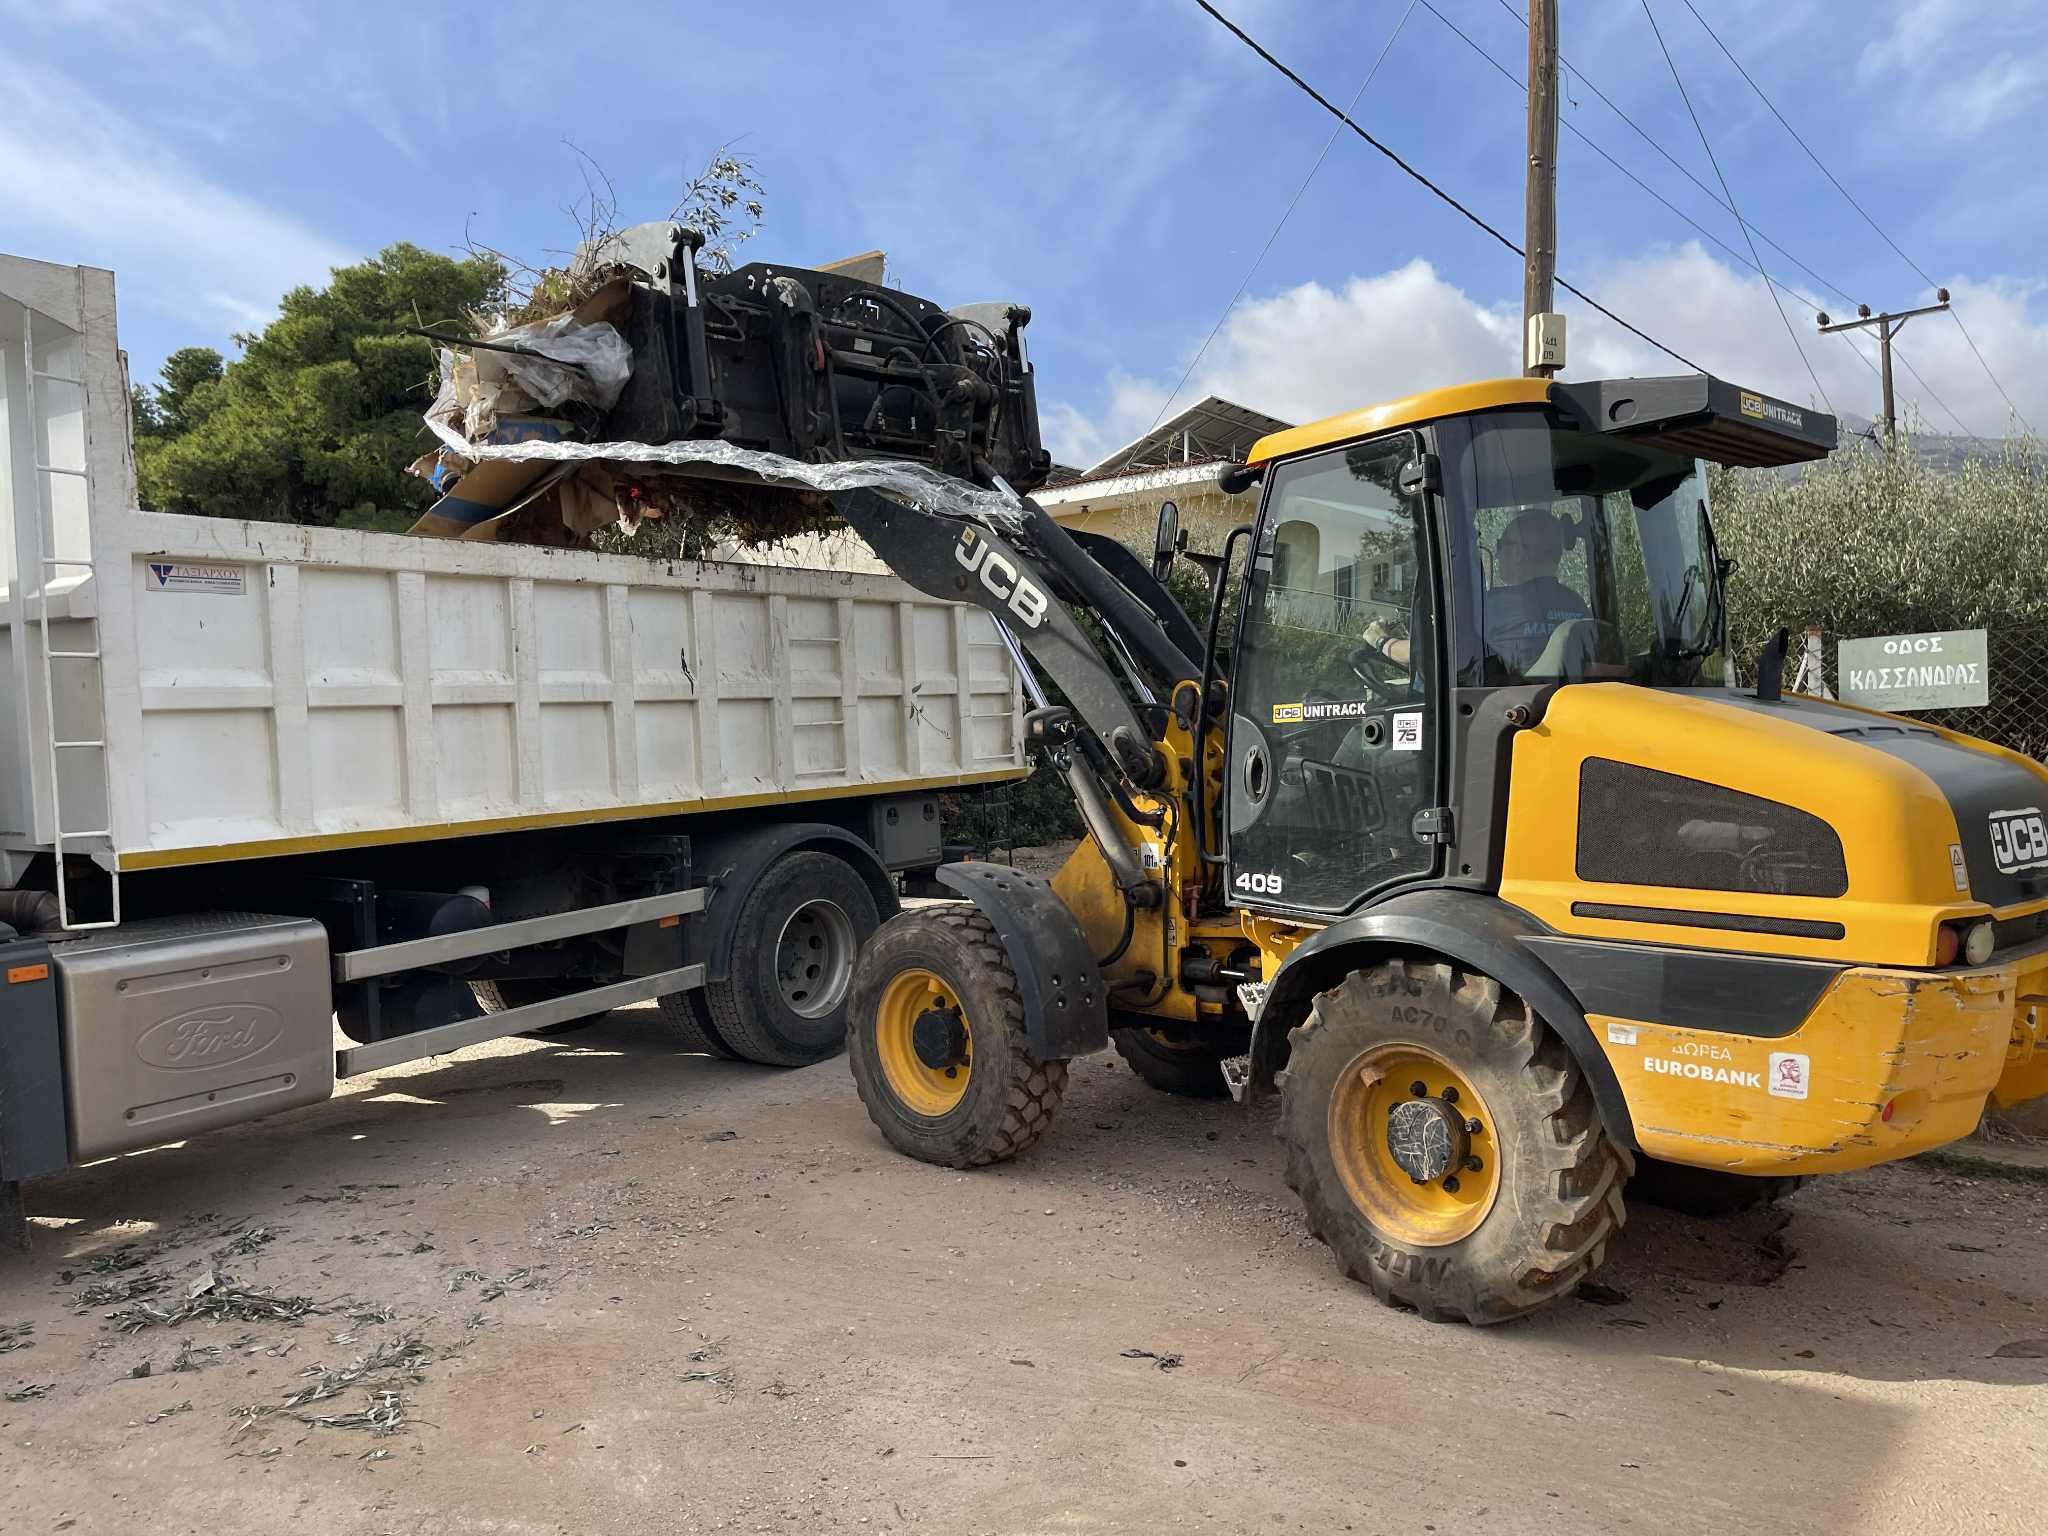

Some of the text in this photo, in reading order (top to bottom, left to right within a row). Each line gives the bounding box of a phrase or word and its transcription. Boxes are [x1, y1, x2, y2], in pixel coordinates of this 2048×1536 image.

[1743, 396, 1802, 427] JCB UNITRACK
[955, 527, 1048, 629] JCB
[1883, 637, 1944, 655] ΟΔΟΣ
[1849, 663, 1981, 691] ΚΑΣΣΑΝΔΡΑΣ
[1275, 702, 1366, 719] JCB UNITRACK
[1397, 728, 1417, 742] 75
[1991, 816, 2048, 864] JCB
[1235, 872, 1282, 894] 409
[166, 1015, 257, 1061] Ford
[1643, 1056, 1761, 1088] EUROBANK
